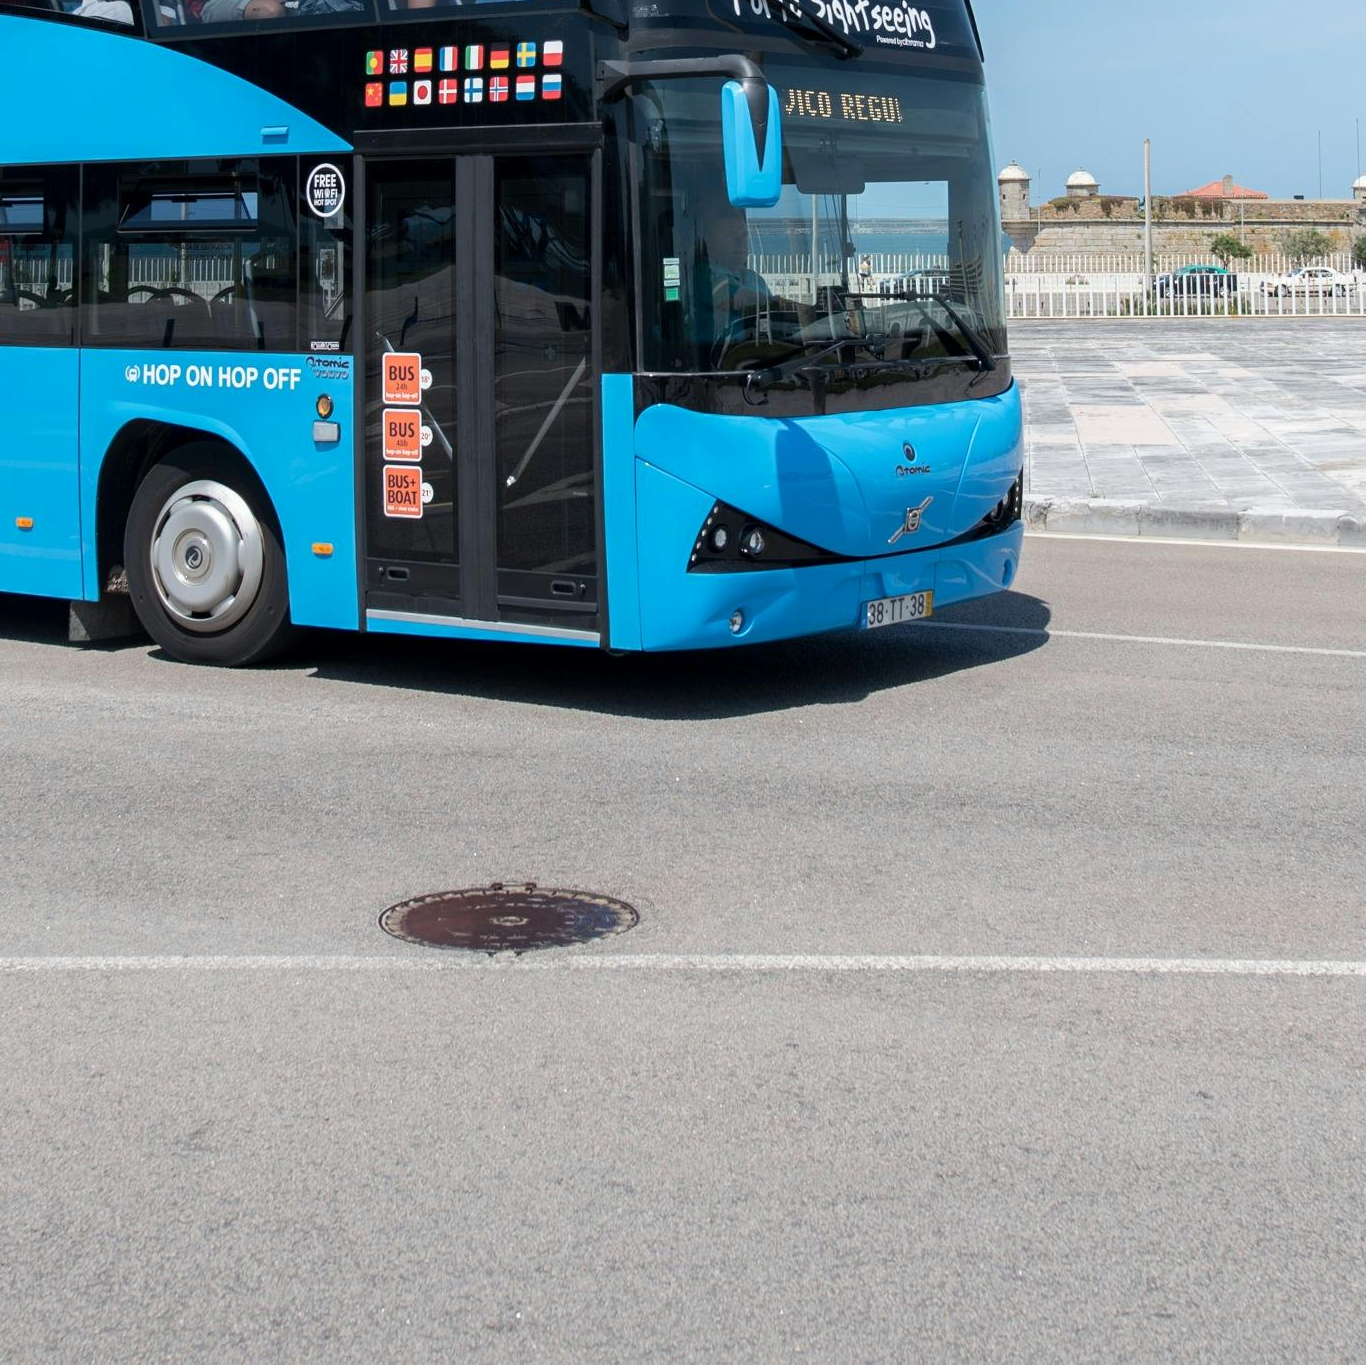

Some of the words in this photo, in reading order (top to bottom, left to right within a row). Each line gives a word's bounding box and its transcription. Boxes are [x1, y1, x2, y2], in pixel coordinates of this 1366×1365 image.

[314, 174, 337, 187] FREE
[143, 364, 181, 386] HOP
[186, 365, 213, 387] ON
[218, 366, 258, 388] HOP
[263, 368, 302, 390] OFF
[389, 365, 415, 381] BUS
[396, 382, 408, 390] 24h
[389, 422, 415, 438] BUS
[388, 490, 417, 505] BOAT
